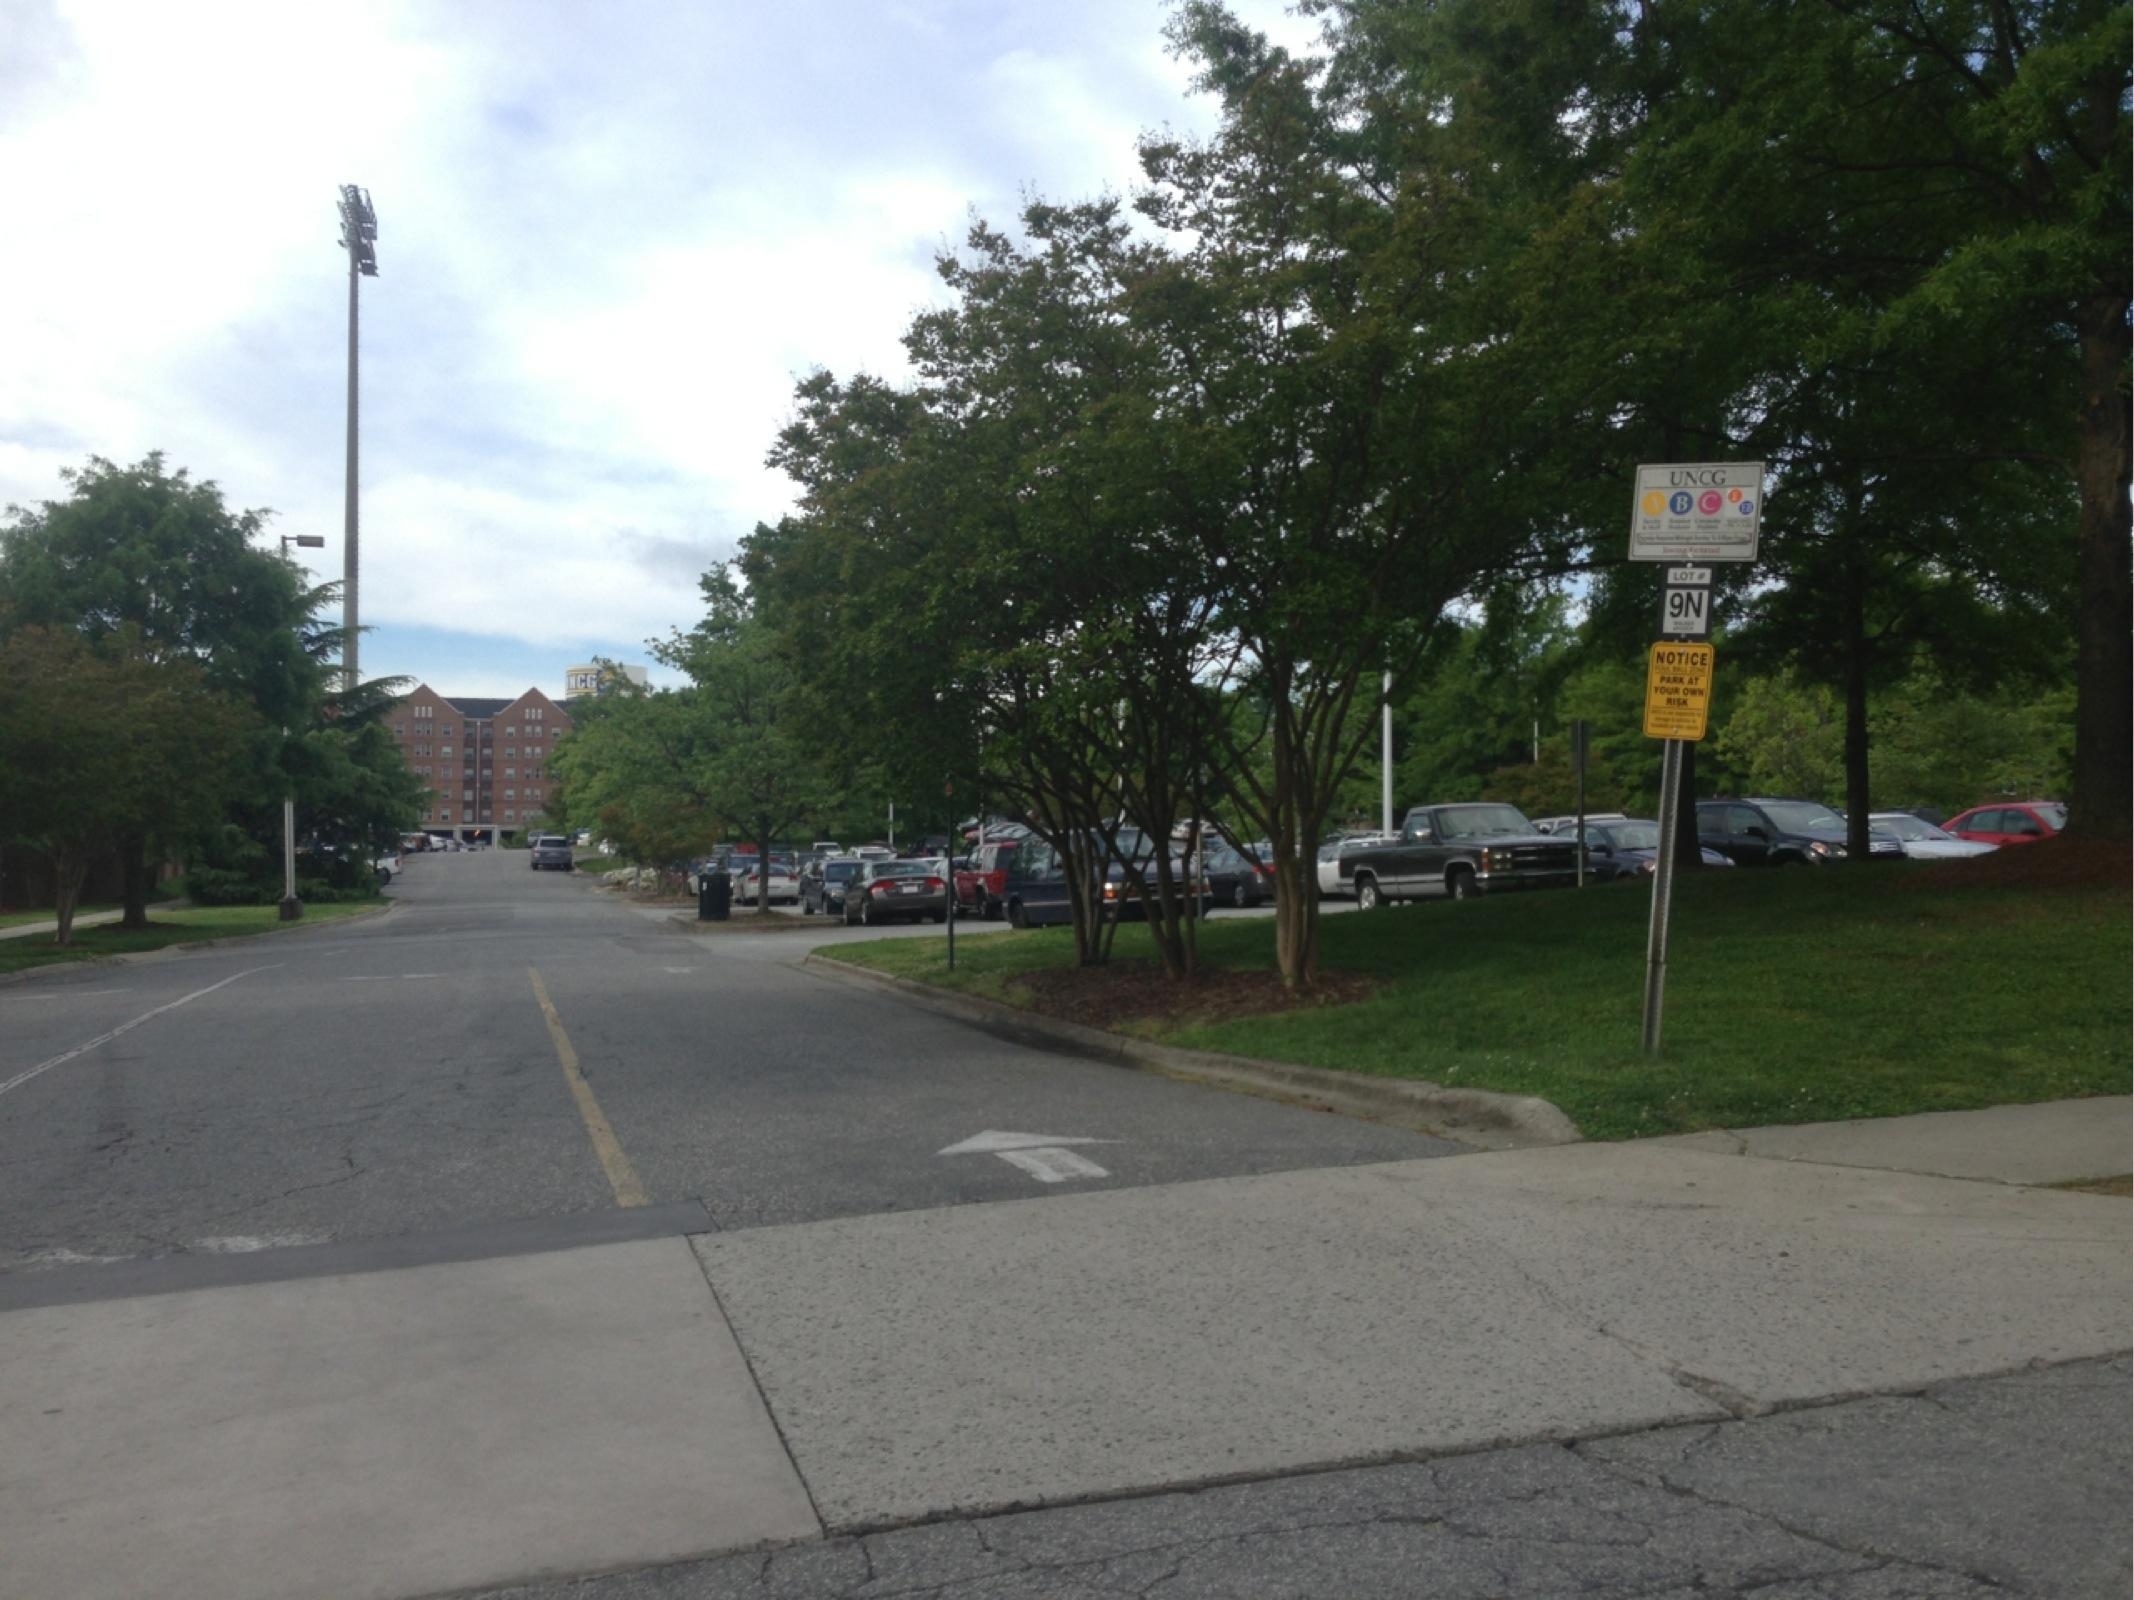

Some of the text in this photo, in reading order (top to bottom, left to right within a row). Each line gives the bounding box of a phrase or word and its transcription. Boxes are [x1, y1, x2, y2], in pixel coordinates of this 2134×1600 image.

[1670, 471, 1726, 486] UNCG
[1676, 496, 1688, 512] B
[1701, 494, 1717, 510] C
[1673, 572, 1695, 581] LOT
[1669, 592, 1702, 618] 9N
[1656, 651, 1708, 666] NOTICE
[1660, 676, 1699, 686] PARK AT
[1654, 687, 1704, 697] YOUR OWN
[1665, 698, 1688, 707] RISK
